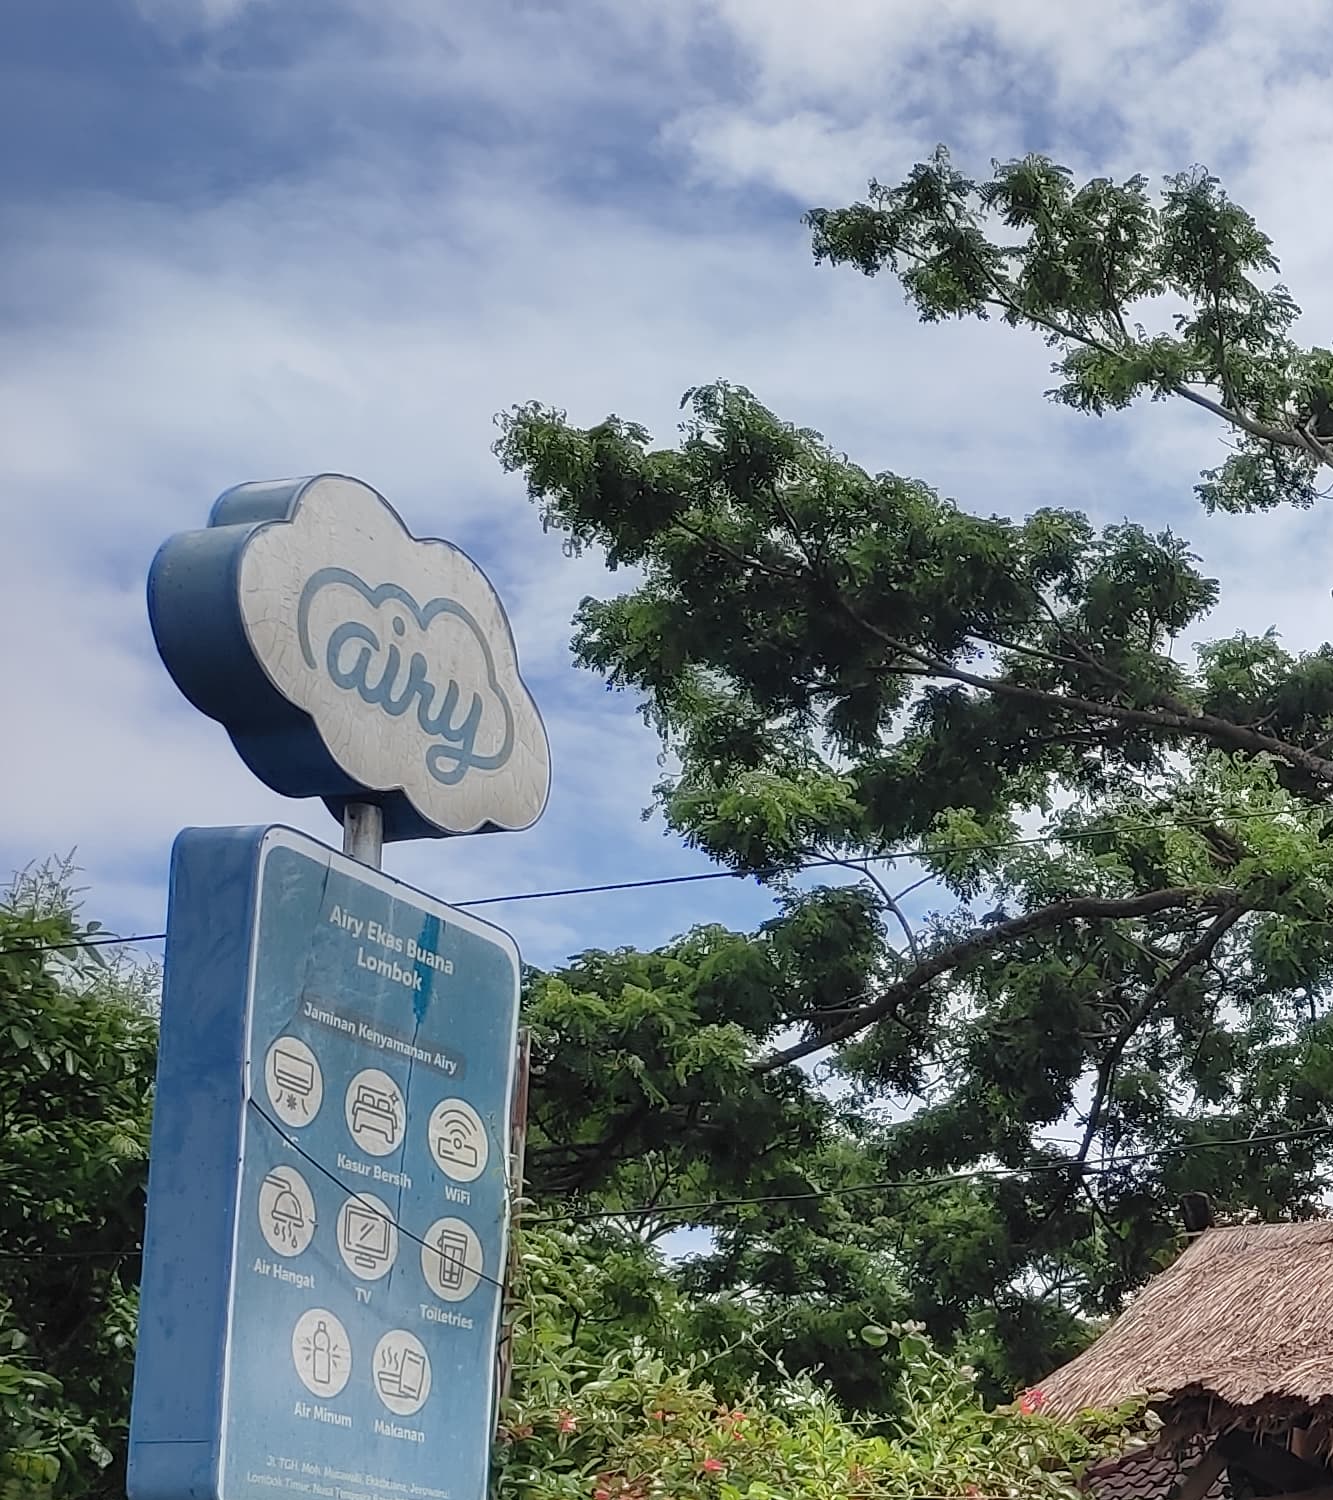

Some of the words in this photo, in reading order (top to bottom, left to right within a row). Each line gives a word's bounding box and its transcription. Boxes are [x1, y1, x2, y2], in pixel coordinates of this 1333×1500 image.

[326, 615, 486, 786] airy
[329, 904, 364, 938] Airy
[367, 921, 403, 953] Ekas
[406, 937, 454, 975] Buana
[357, 947, 423, 991] Lombok
[304, 1001, 356, 1034] Jaminan
[358, 1022, 431, 1064] Kenyamanan
[433, 1052, 457, 1075] Airy
[337, 1153, 371, 1179] Kasur
[373, 1165, 412, 1189] Bersih
[444, 1185, 471, 1206] WiFi
[253, 1258, 271, 1276] Air
[273, 1264, 315, 1290] Hangat
[355, 1288, 372, 1304] TV
[420, 1304, 474, 1329] Toiletries
[294, 1402, 311, 1420] Air
[313, 1405, 352, 1428] Minum
[374, 1419, 425, 1443] Makanan
